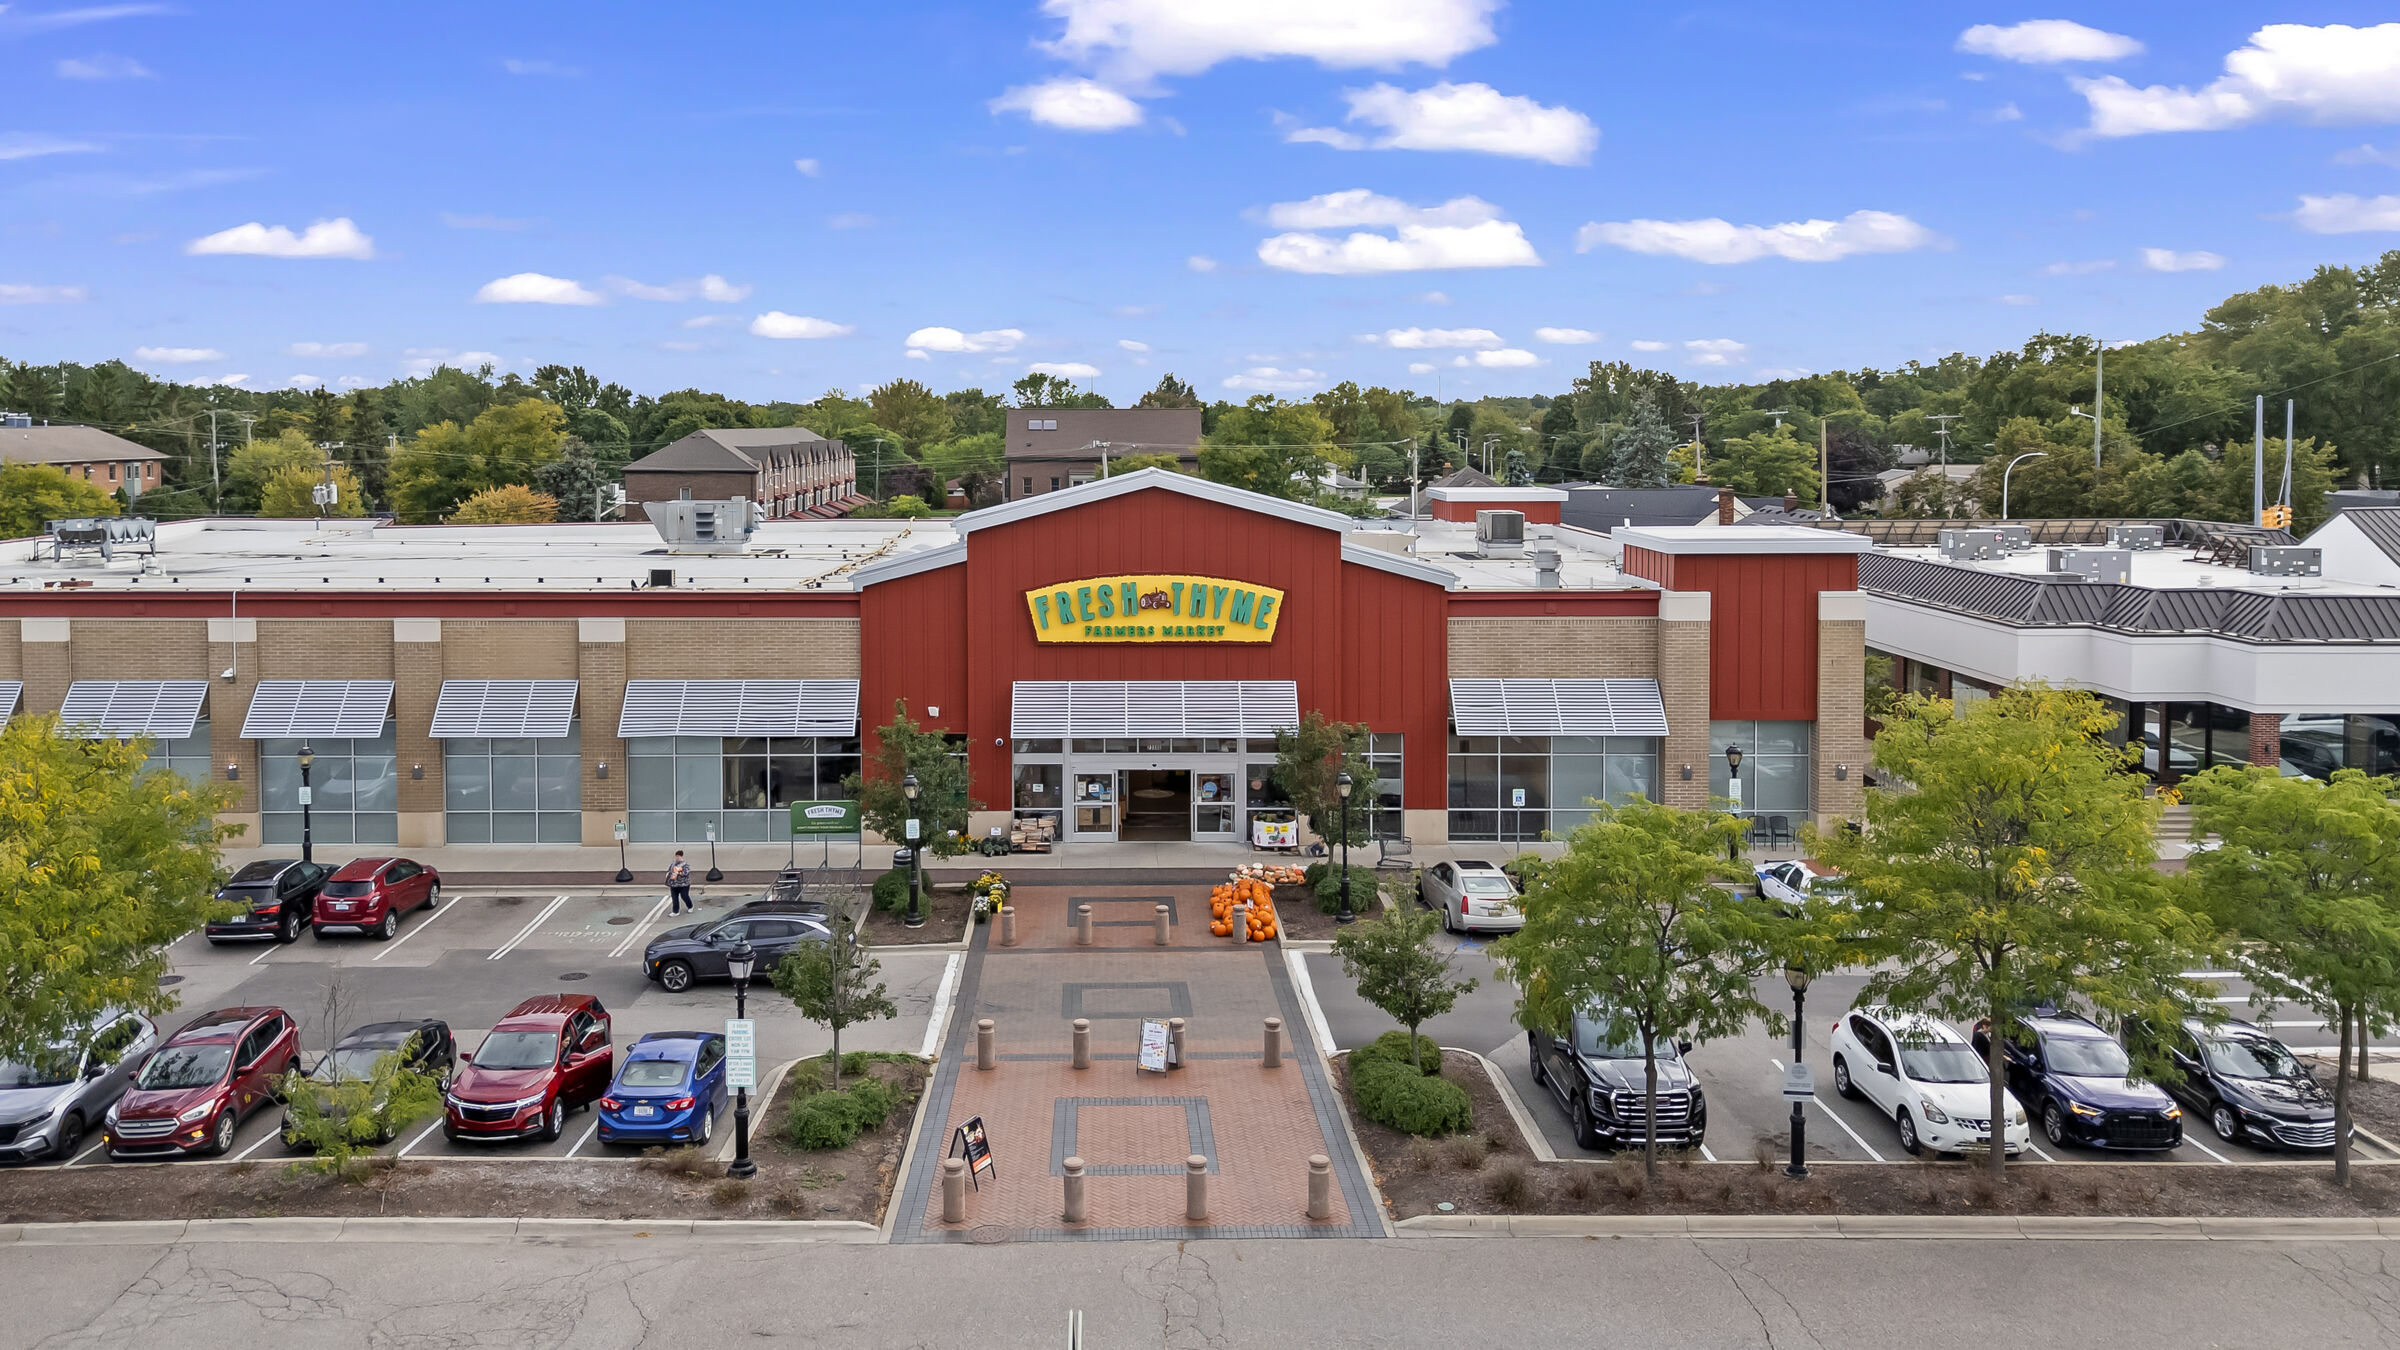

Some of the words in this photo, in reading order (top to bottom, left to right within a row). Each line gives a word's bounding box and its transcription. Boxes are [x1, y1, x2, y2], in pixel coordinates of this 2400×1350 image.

[1034, 581, 1139, 630] FRESH
[1171, 582, 1276, 630] THYME
[1085, 626, 1154, 636] FARMERS
[1162, 626, 1225, 636] MARKET
[825, 807, 844, 815] THYME
